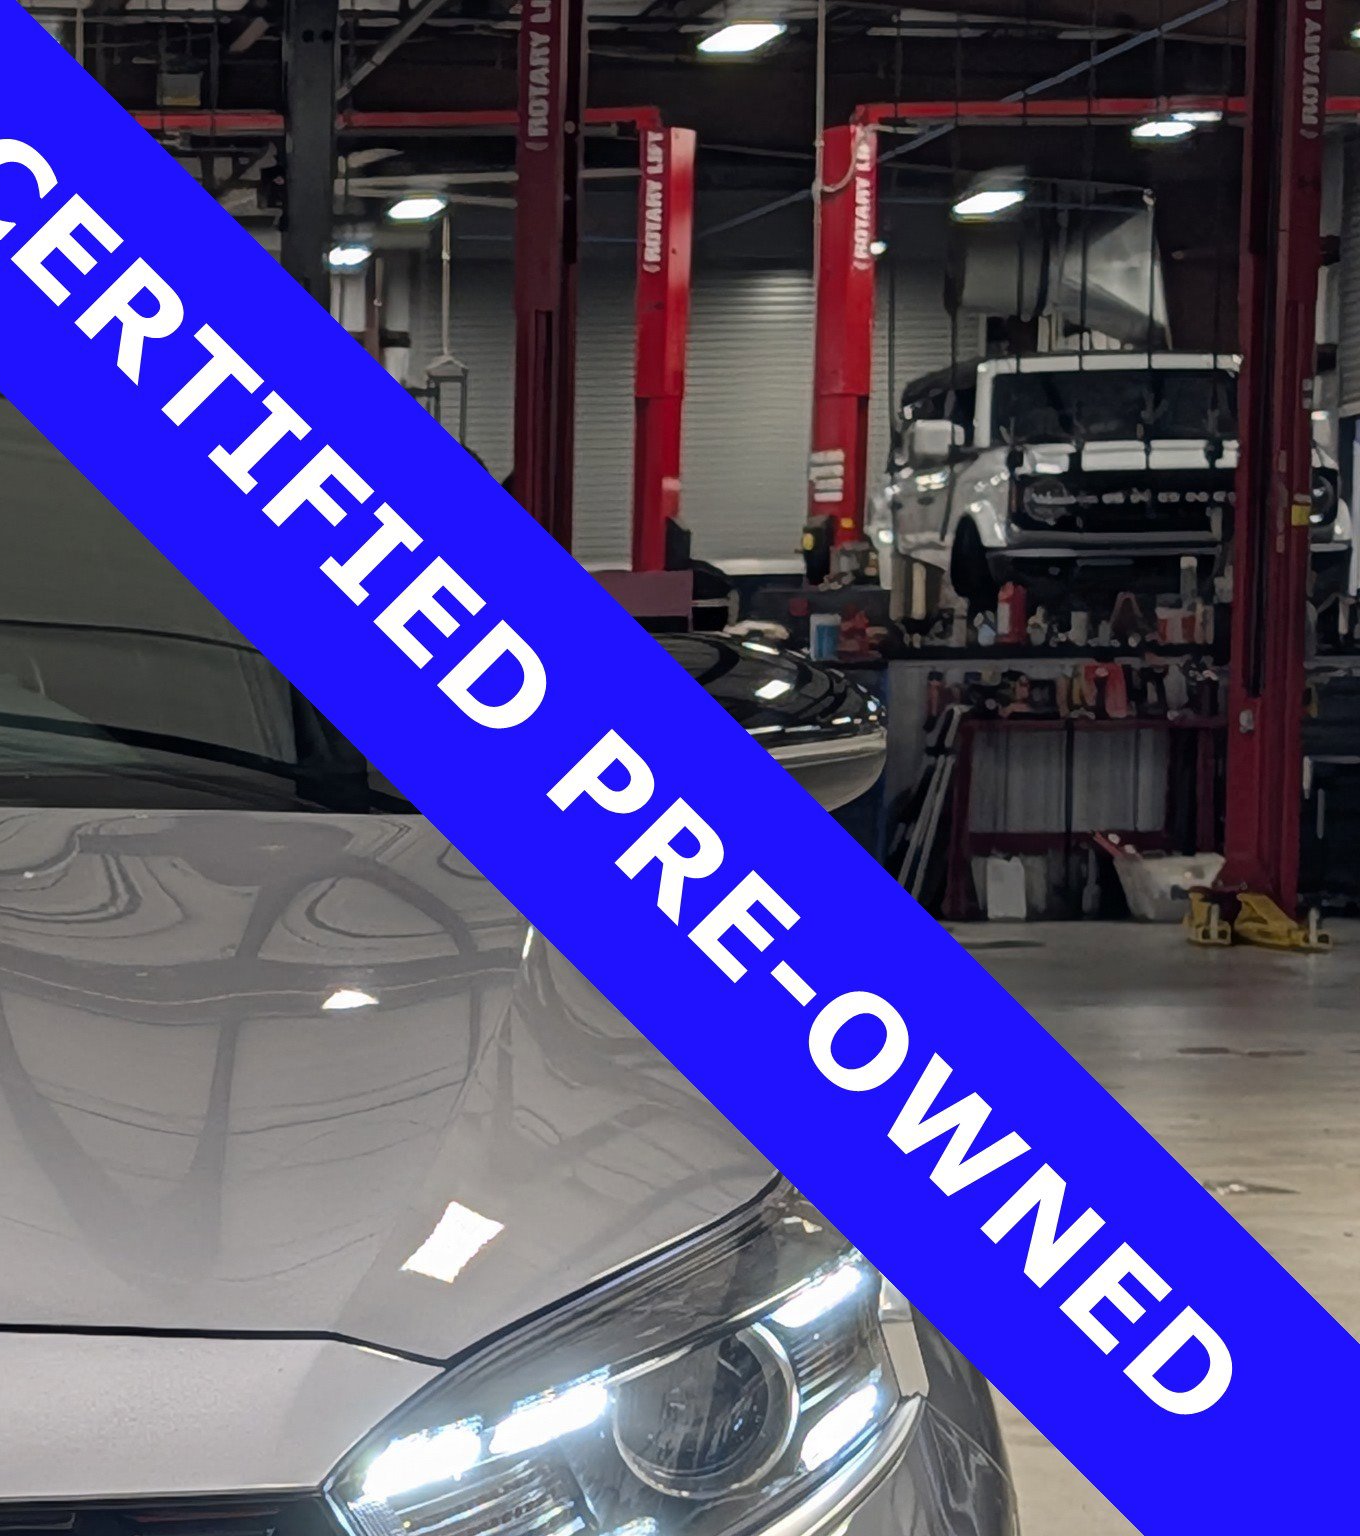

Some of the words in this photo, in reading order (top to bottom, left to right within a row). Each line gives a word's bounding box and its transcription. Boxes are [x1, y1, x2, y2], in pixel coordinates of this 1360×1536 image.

[527, 31, 551, 137] ROTARY
[1302, 18, 1321, 125] ROTARY
[646, 131, 664, 174] LIFT
[644, 179, 663, 263] ROTARY
[853, 177, 871, 259] ROTARY
